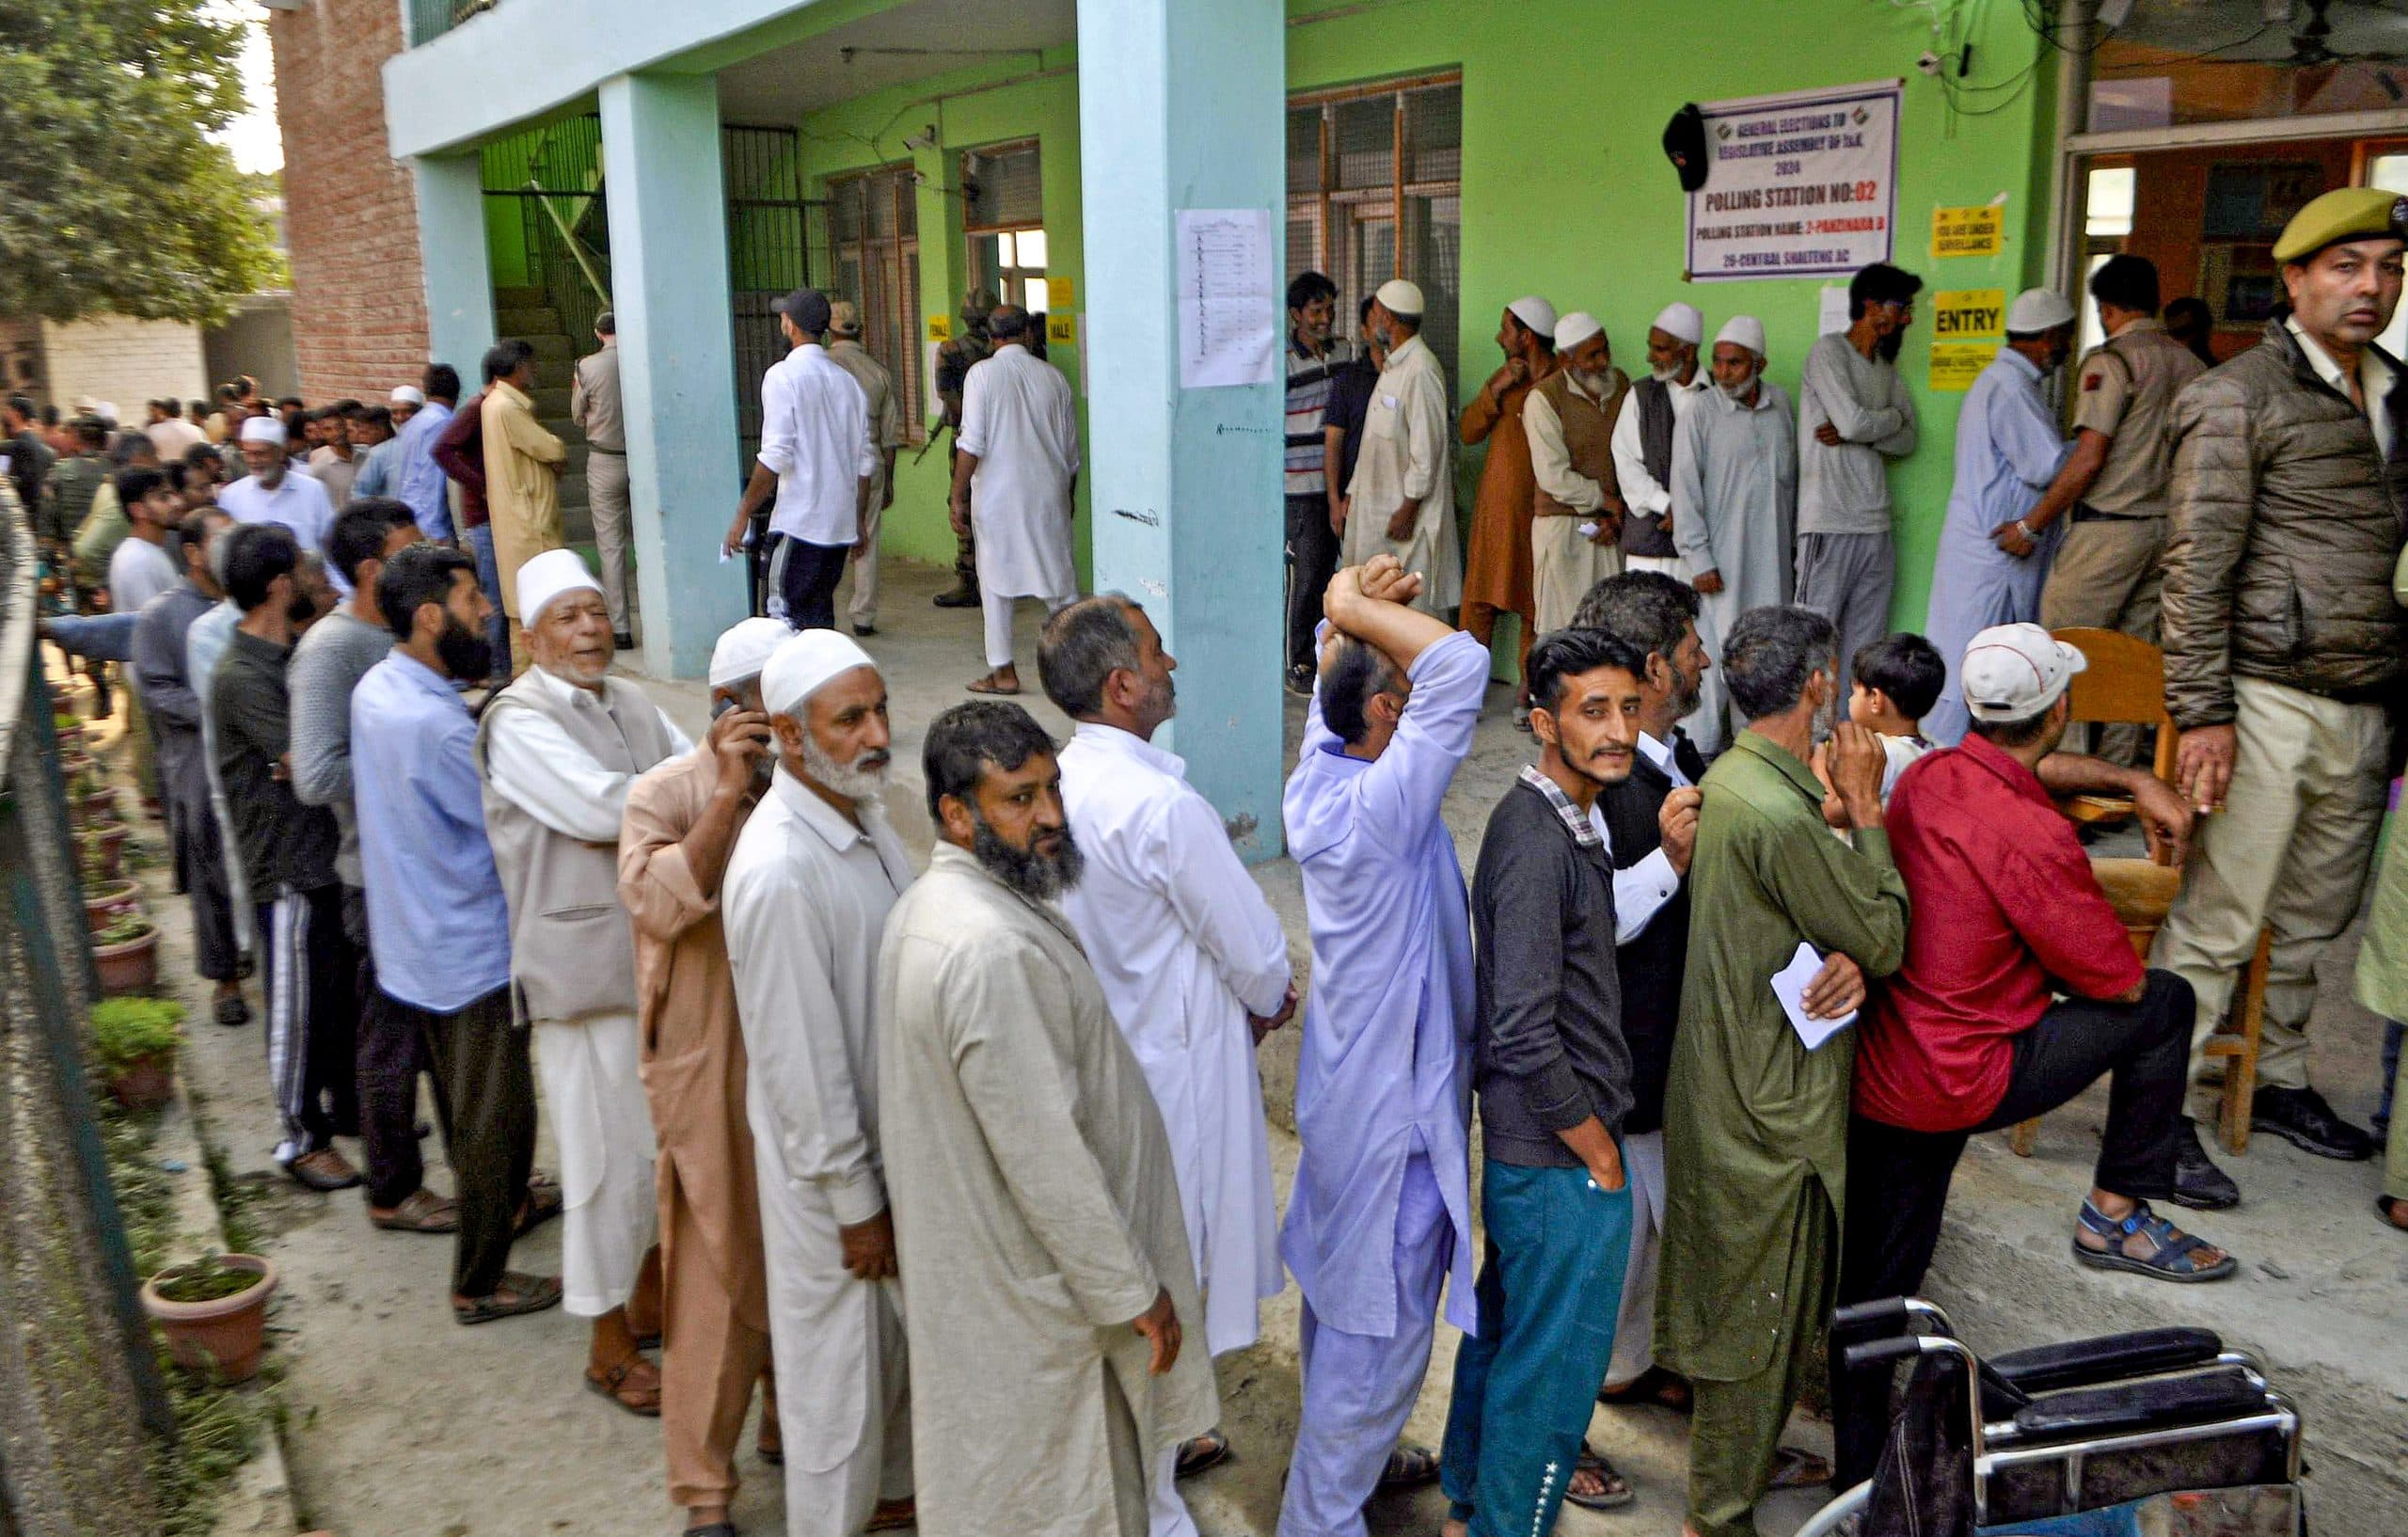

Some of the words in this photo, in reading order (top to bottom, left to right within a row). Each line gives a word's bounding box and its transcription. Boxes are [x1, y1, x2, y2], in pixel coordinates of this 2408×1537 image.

[1705, 189, 1761, 213] POLLING
[1765, 184, 1826, 209] STATION
[1696, 226, 1732, 241] POLLING
[1735, 223, 1772, 239] STATION
[1937, 308, 1999, 332] ENTRY
[1050, 323, 1070, 339] MALE
